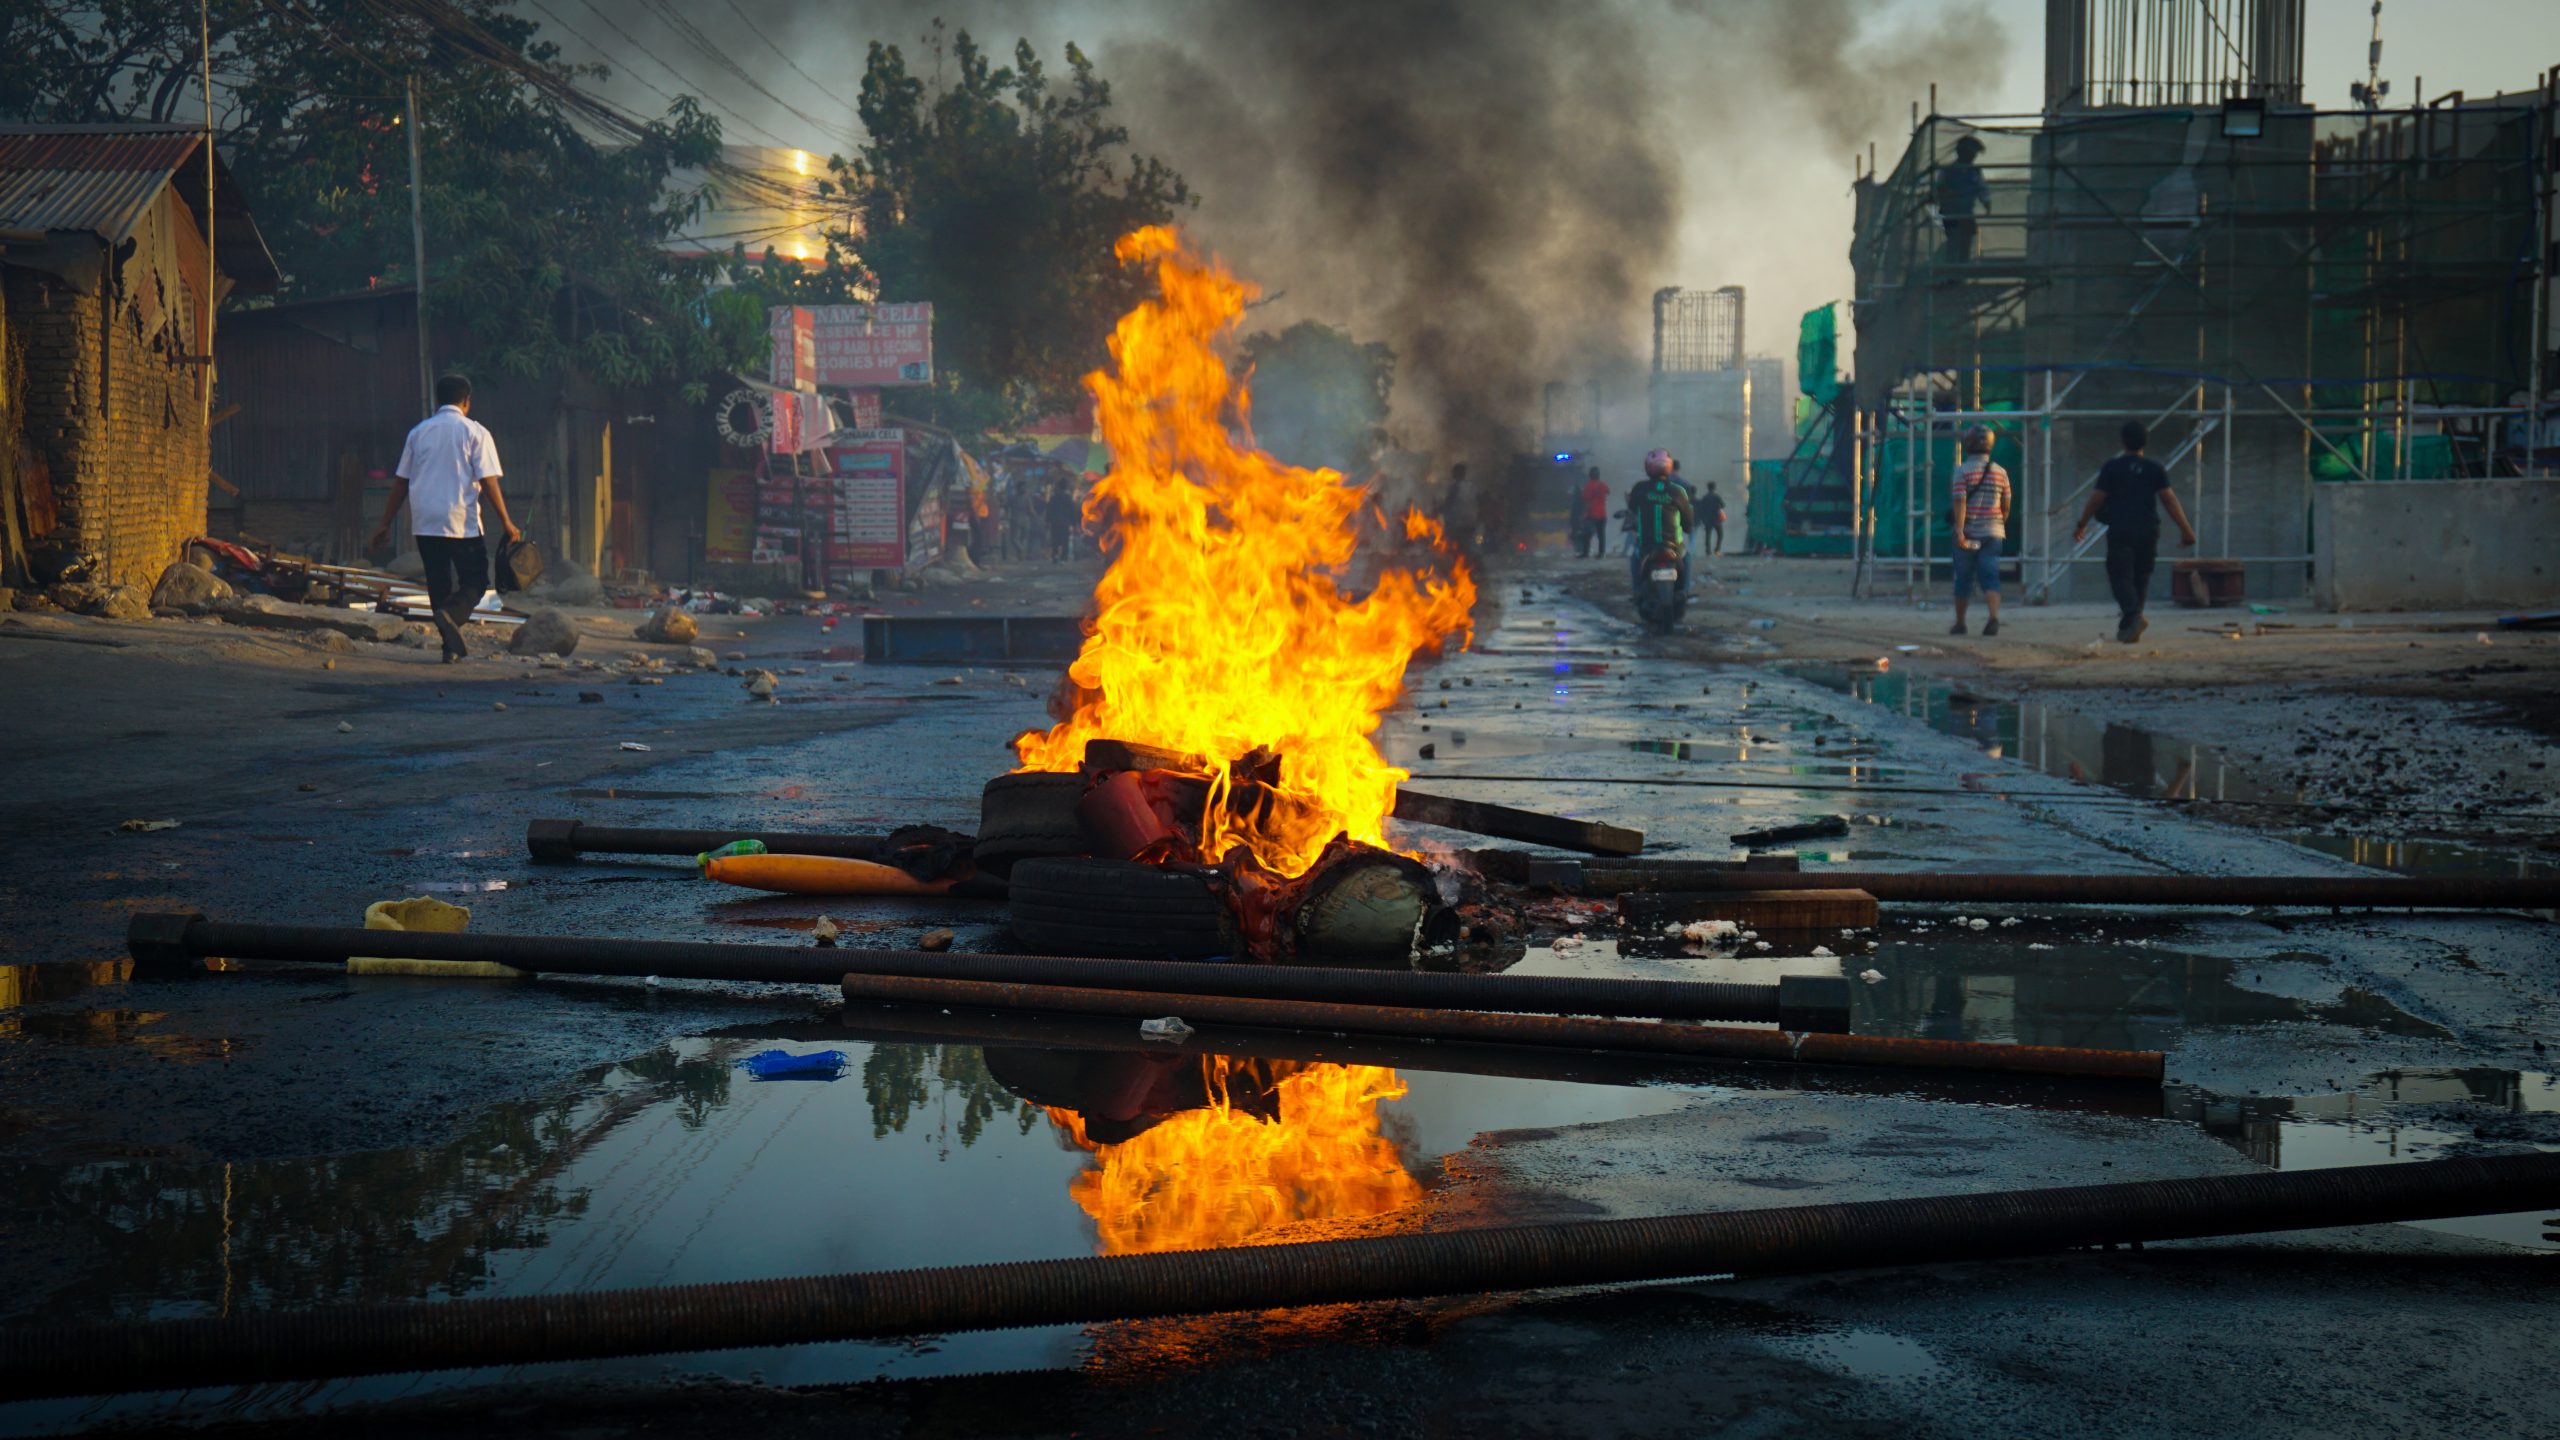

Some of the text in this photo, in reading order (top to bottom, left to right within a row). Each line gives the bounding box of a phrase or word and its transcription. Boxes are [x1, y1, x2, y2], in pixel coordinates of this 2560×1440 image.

[877, 306, 922, 321] CELL
[825, 324, 890, 338] SERVCE
[895, 324, 917, 338] HP
[877, 355, 898, 369] HP
[878, 430, 898, 440] CELL
